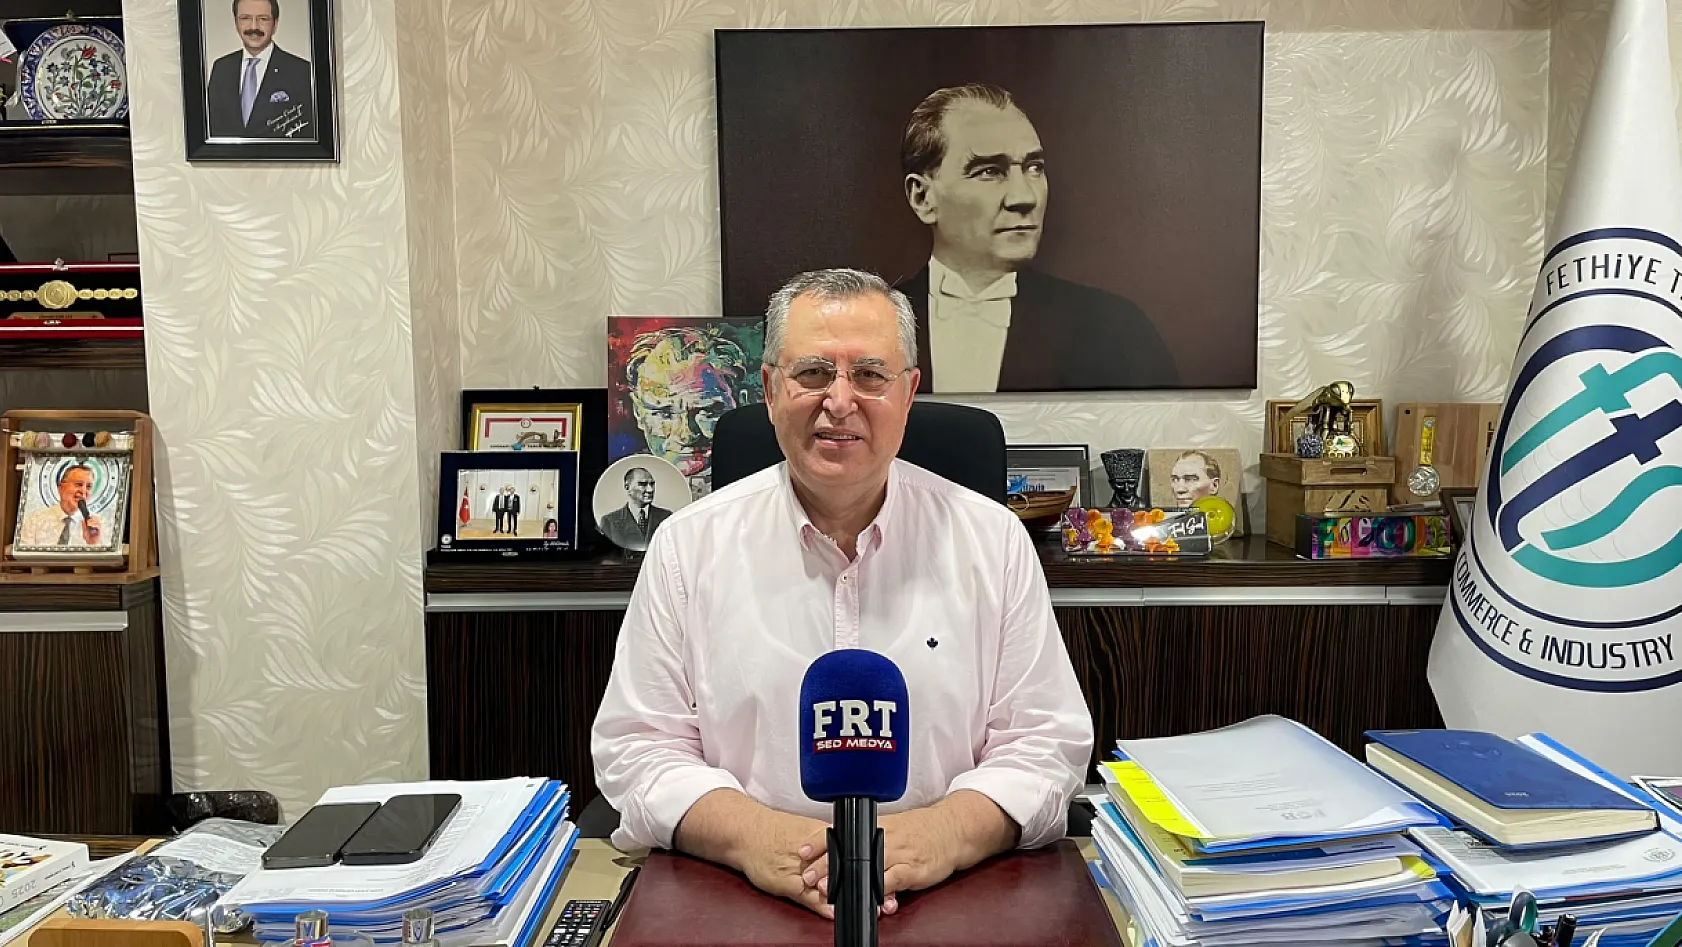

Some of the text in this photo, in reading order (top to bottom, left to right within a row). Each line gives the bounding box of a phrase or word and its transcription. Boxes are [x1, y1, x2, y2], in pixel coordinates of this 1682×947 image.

[1456, 551, 1675, 669] COMMERCE & INDUSTRY
[813, 699, 897, 739] FRT
[846, 738, 893, 749] MEDYA
